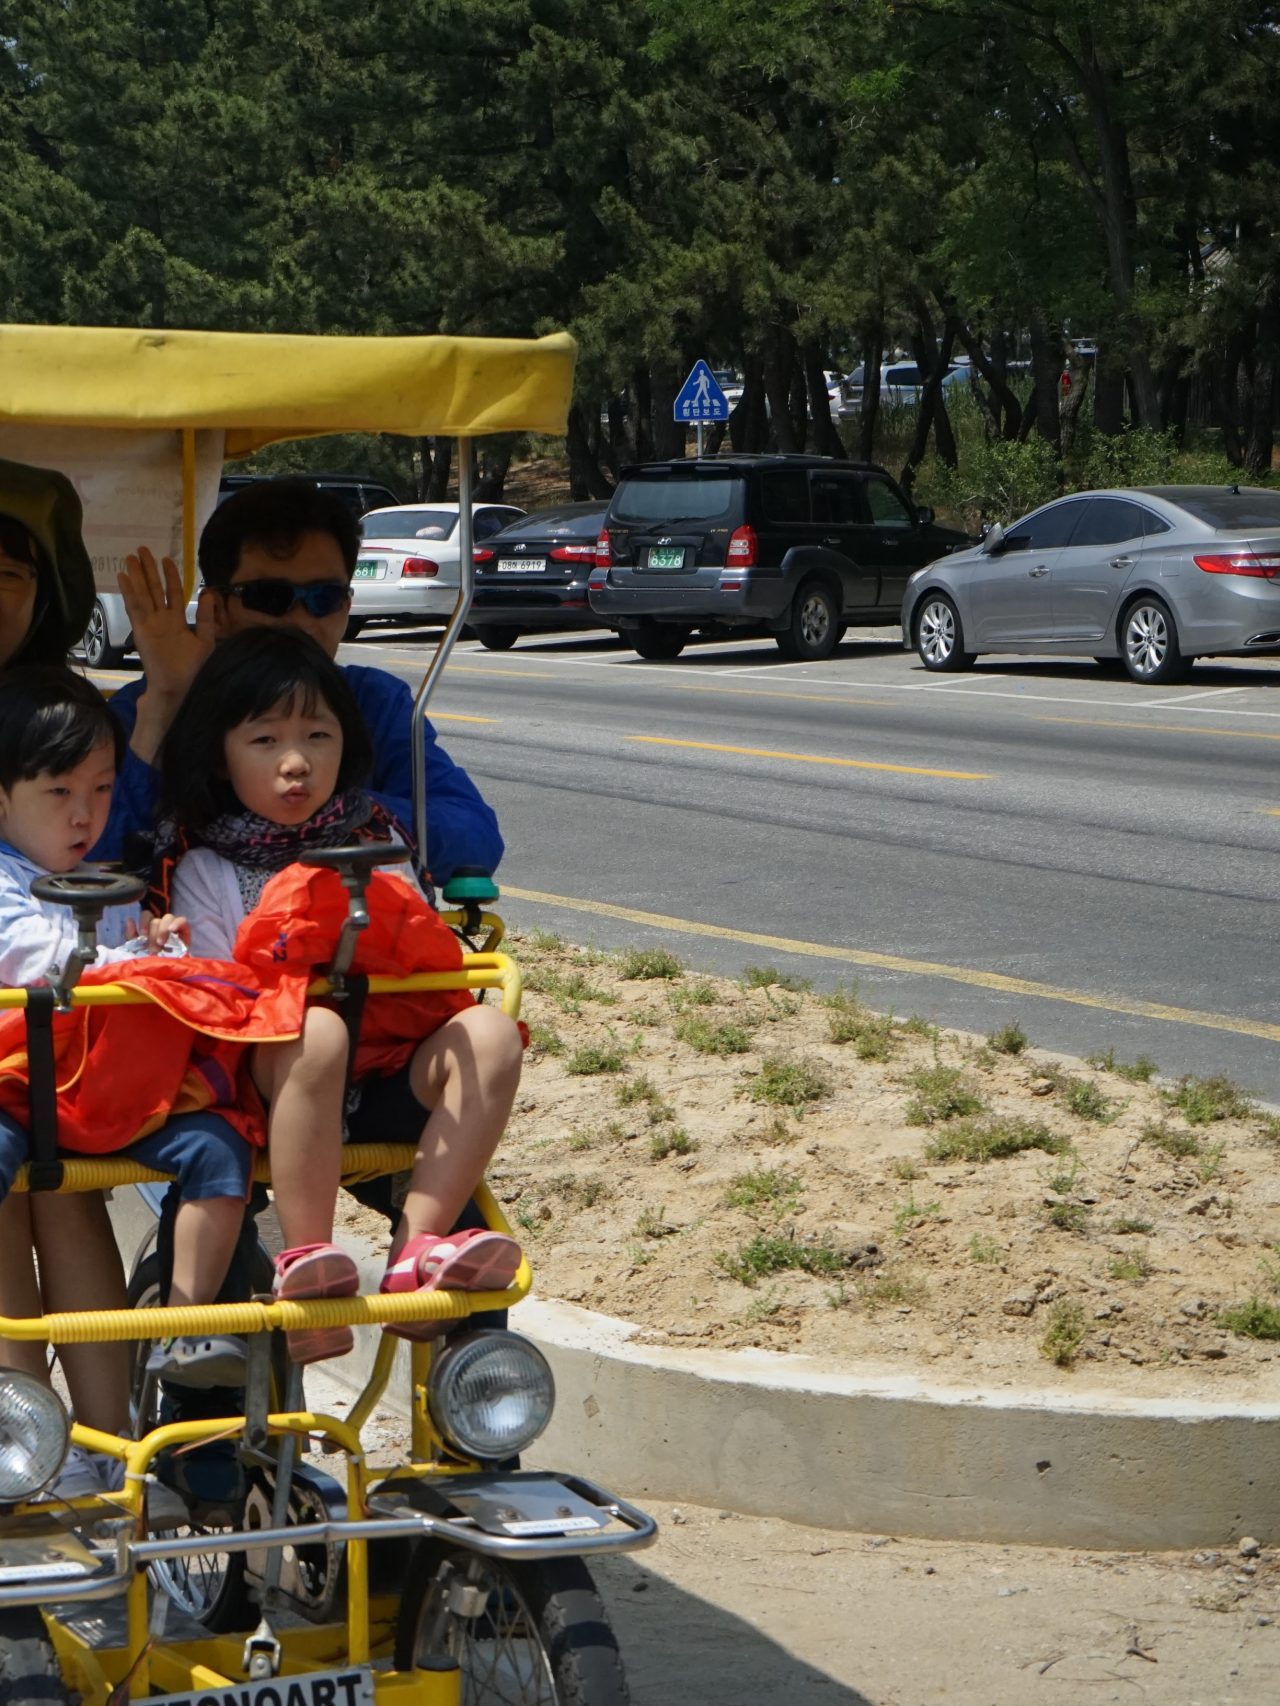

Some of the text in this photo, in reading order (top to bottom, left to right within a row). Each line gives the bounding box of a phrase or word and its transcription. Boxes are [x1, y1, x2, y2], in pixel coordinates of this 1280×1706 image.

[683, 408, 722, 416] 횡단보도
[520, 560, 542, 570] 6919
[651, 554, 681, 566] 8378
[354, 564, 374, 577] 681
